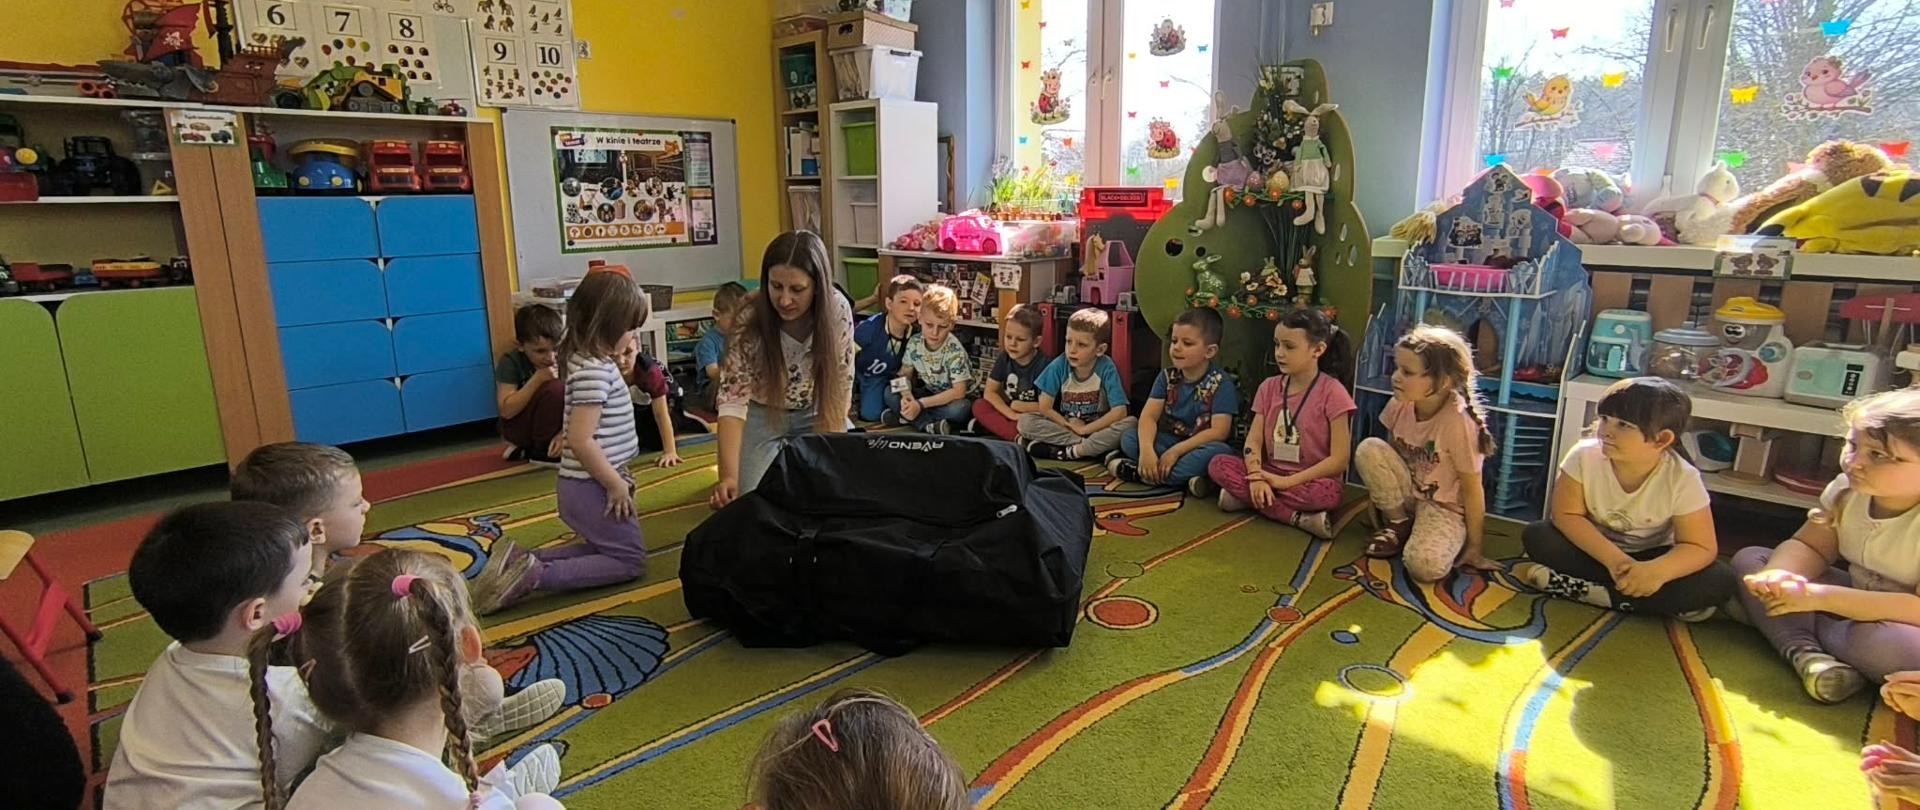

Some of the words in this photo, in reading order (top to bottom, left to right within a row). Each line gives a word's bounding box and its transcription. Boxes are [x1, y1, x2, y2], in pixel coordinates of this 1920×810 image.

[267, 4, 286, 26] 6
[334, 11, 351, 32] 7
[399, 18, 415, 39] 8
[493, 42, 507, 61] 9
[539, 46, 561, 65] 10
[596, 136, 604, 144] W
[606, 136, 625, 145] kinie
[632, 136, 661, 146] teatrze
[867, 358, 888, 375] 10
[888, 440, 944, 452] AVEND
